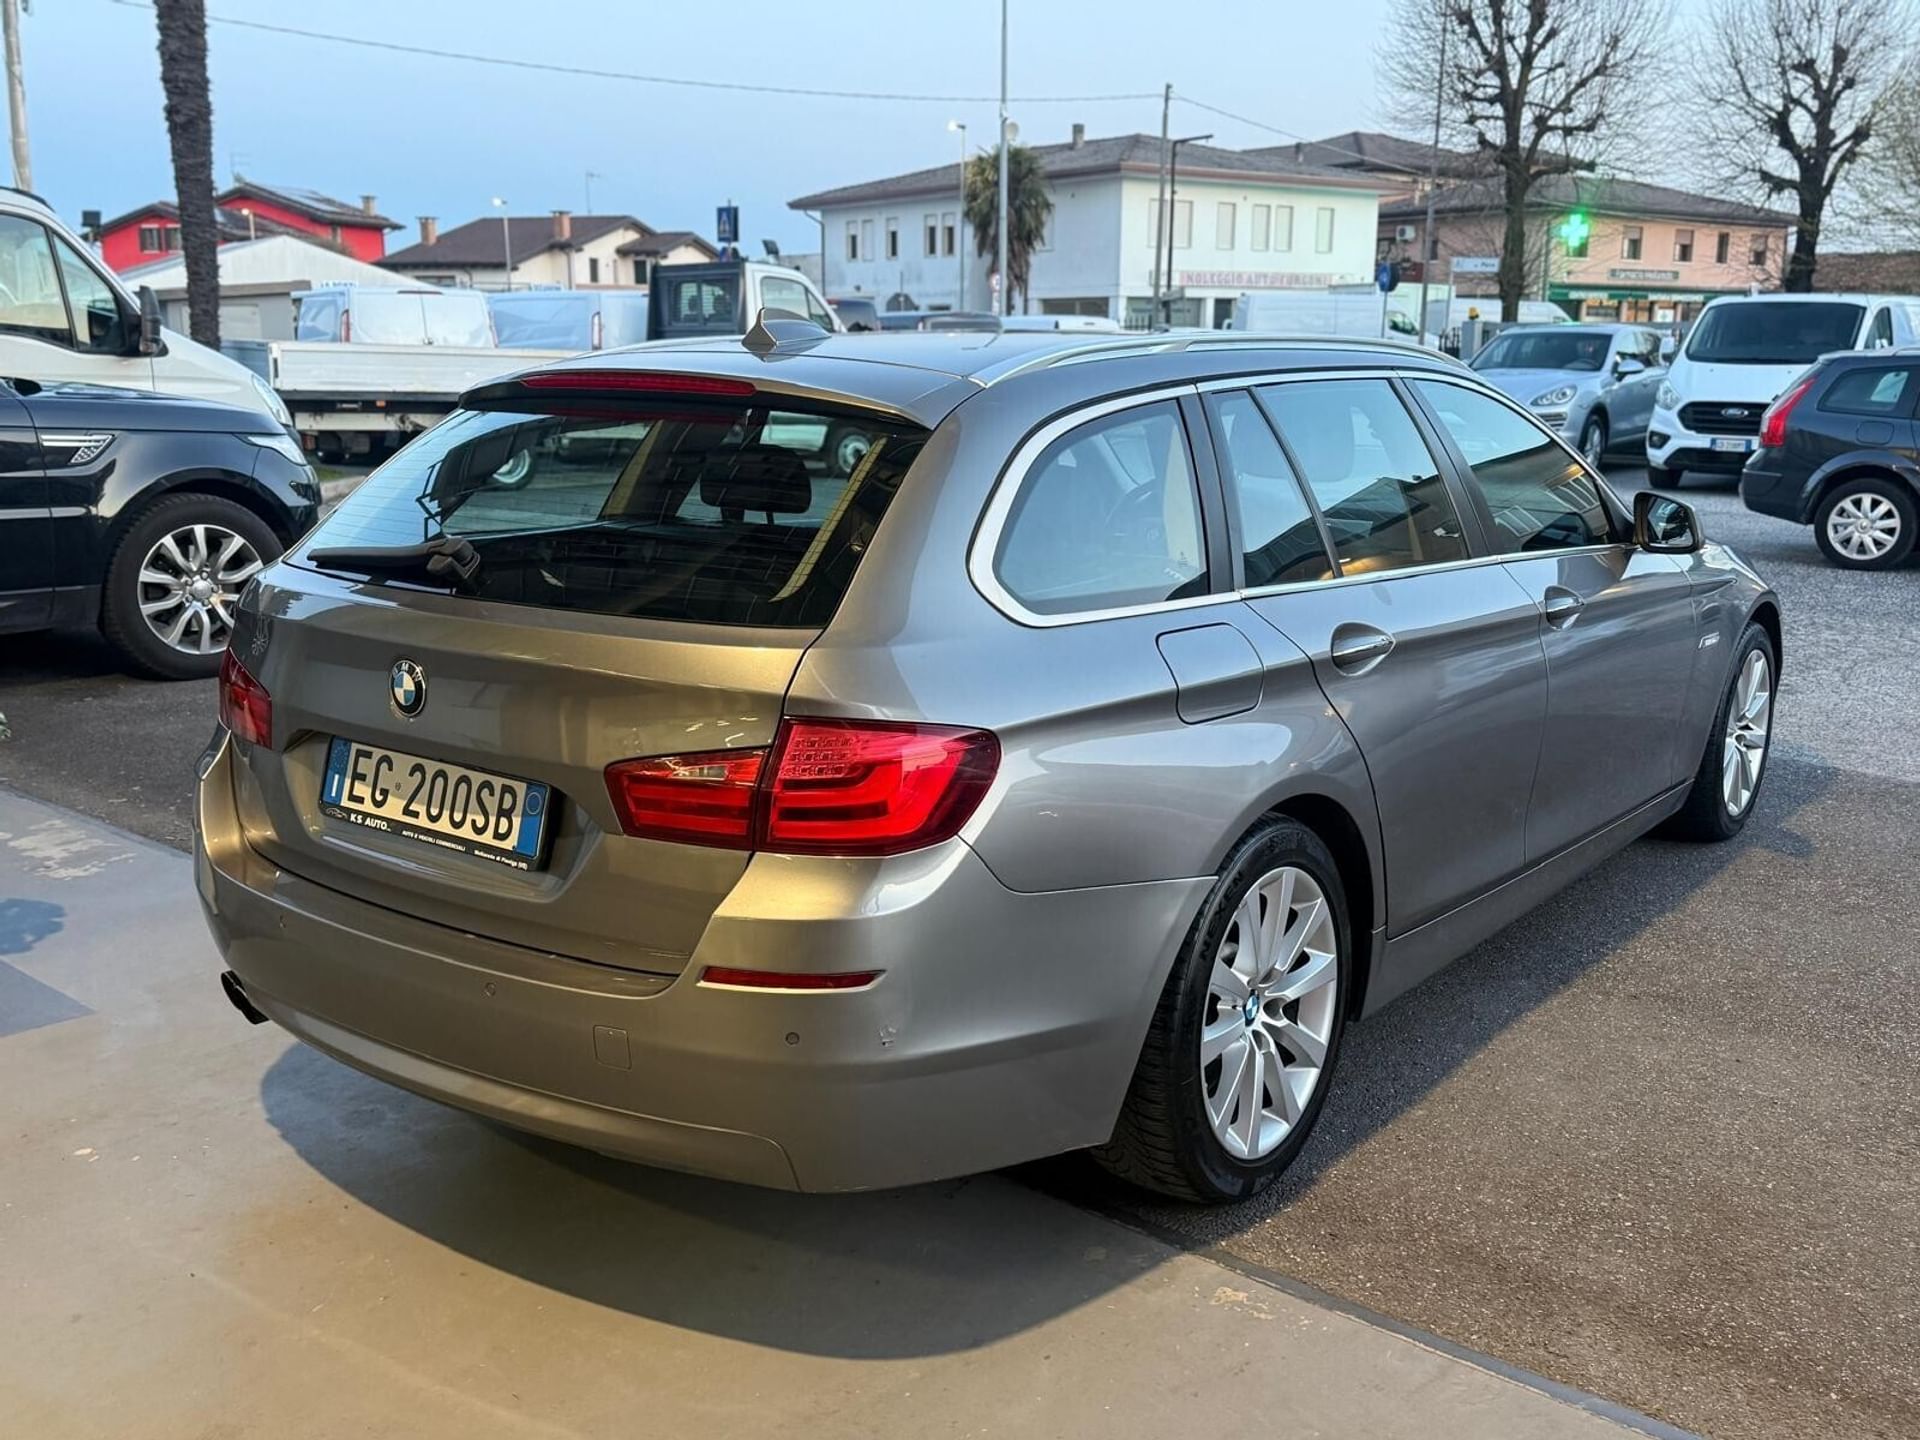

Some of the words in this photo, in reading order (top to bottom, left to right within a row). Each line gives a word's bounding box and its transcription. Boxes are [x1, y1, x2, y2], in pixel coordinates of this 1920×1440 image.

[1186, 271, 1243, 286] NOLEGGIO
[331, 773, 340, 797] I
[347, 748, 394, 809] EG
[402, 763, 518, 842] 200SB
[364, 817, 388, 830] AUTO
[1200, 871, 1246, 961] NEXEN
